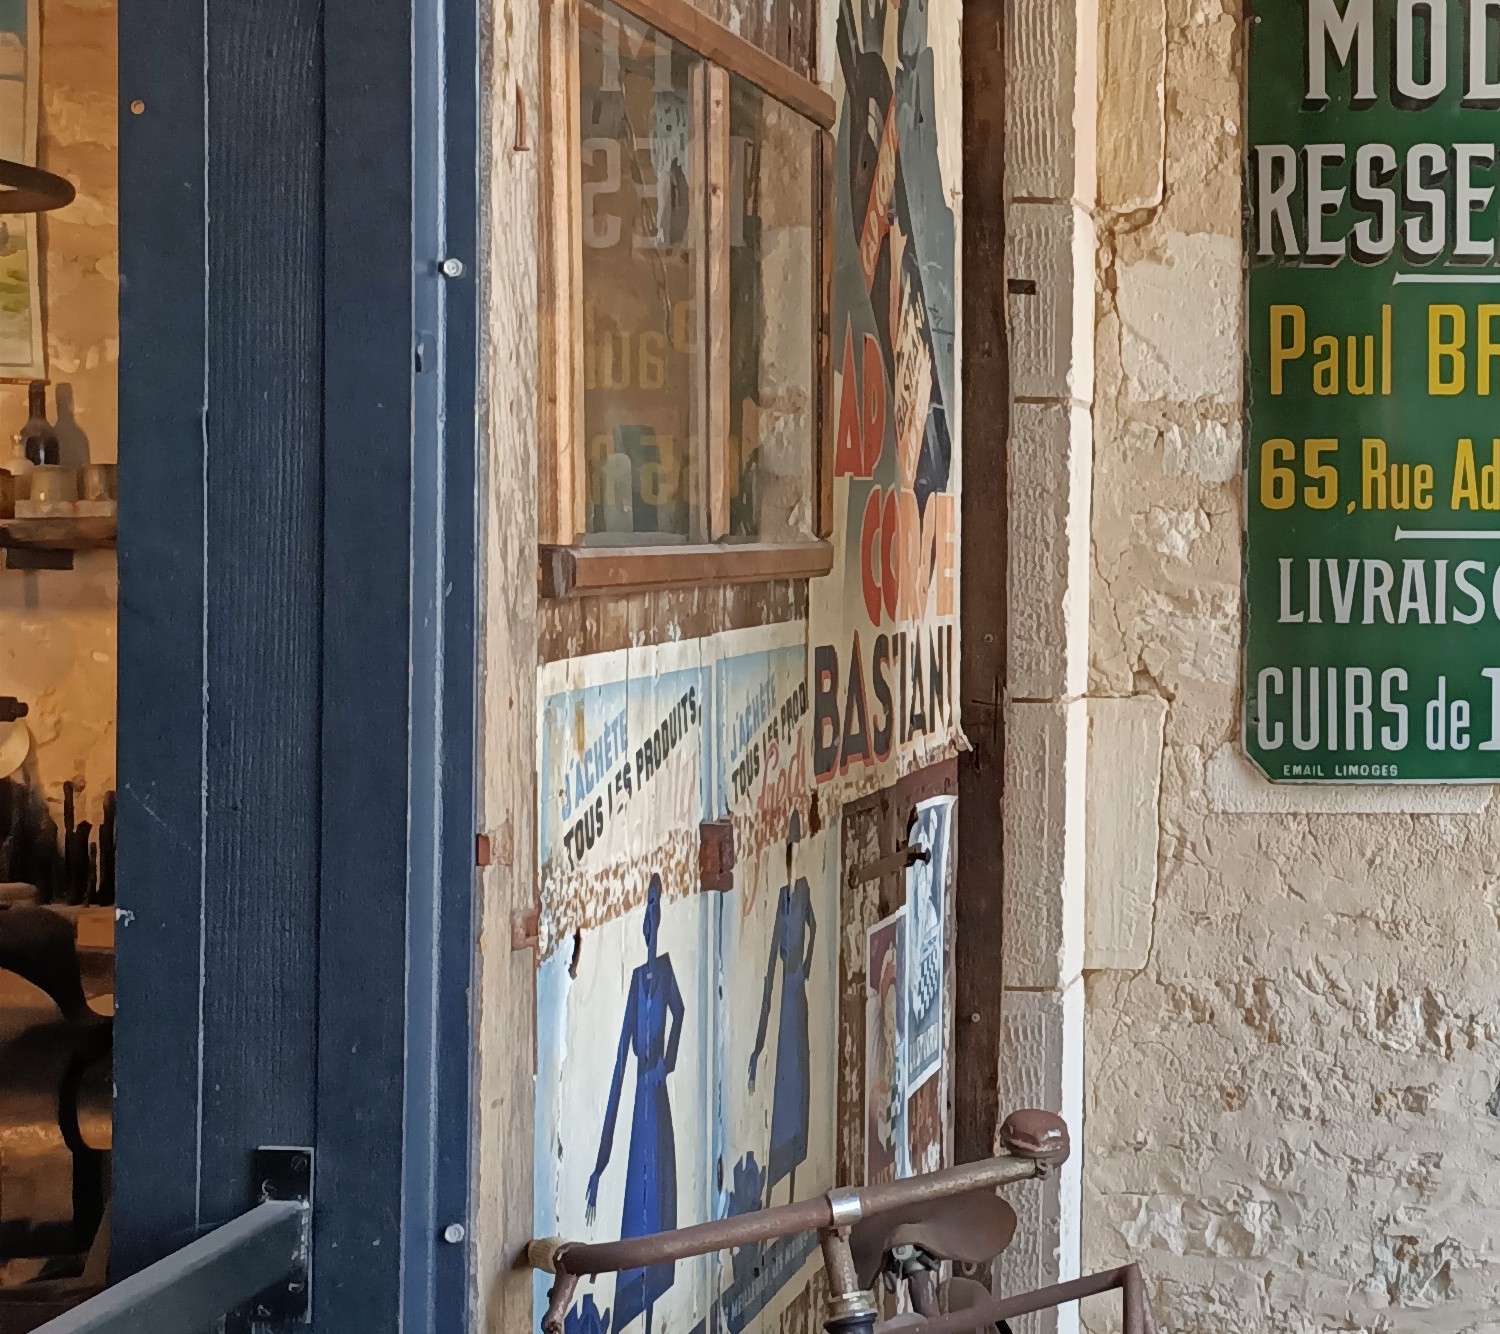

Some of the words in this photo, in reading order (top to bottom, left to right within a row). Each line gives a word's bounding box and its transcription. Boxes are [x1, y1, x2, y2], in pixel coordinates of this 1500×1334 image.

[1269, 303, 1391, 397] Paul
[861, 483, 955, 628] CORSE
[814, 624, 955, 784] BASTIANI
[1258, 667, 1408, 751] CUIRS
[1427, 693, 1470, 751] de
[1283, 763, 1330, 778] EMAIL
[1334, 763, 1399, 778] LIMOGES
[564, 792, 604, 872] TOUS
